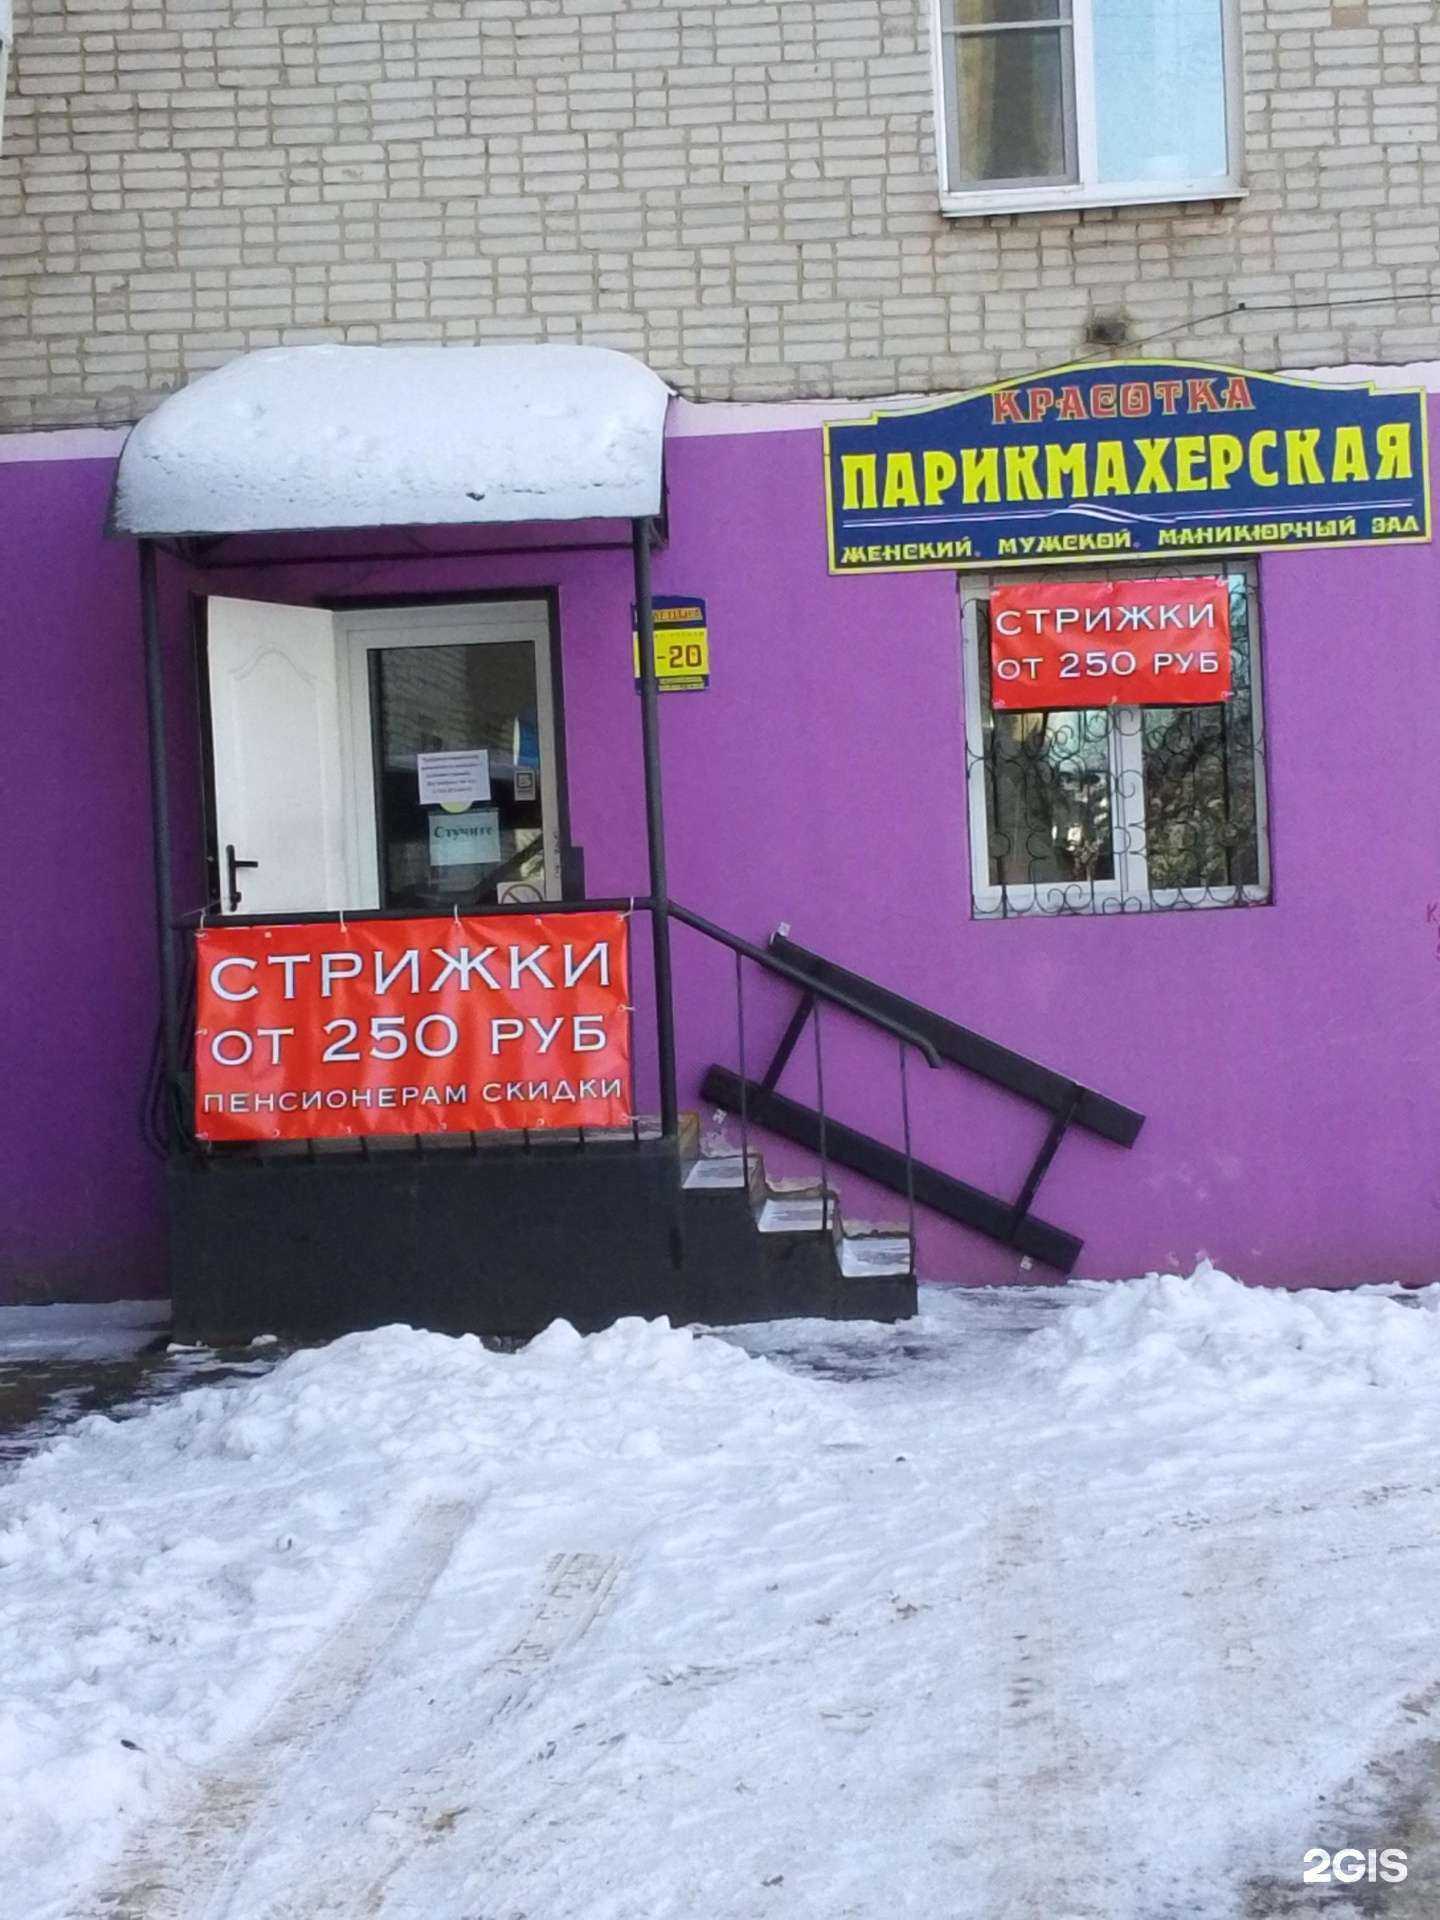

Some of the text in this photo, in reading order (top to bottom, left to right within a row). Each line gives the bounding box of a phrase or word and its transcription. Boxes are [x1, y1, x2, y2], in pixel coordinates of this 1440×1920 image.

[991, 375, 1256, 426] КРАСОТКА
[840, 423, 1413, 511] ПАРИКМАХЕРСКАЯ
[1158, 516, 1356, 546] МАНИКЮРНЫЙ
[1372, 515, 1419, 533] ЗАЛ
[996, 604, 1215, 636] СТРИЖКИ
[996, 651, 1218, 680] ОТ 250 РУБ
[210, 942, 610, 1001] СТРИЖКИ
[211, 1013, 607, 1065] ОТ 250 РУБ
[203, 1078, 621, 1113] ПЕНСИОНЕРАМ СКИДКИ
